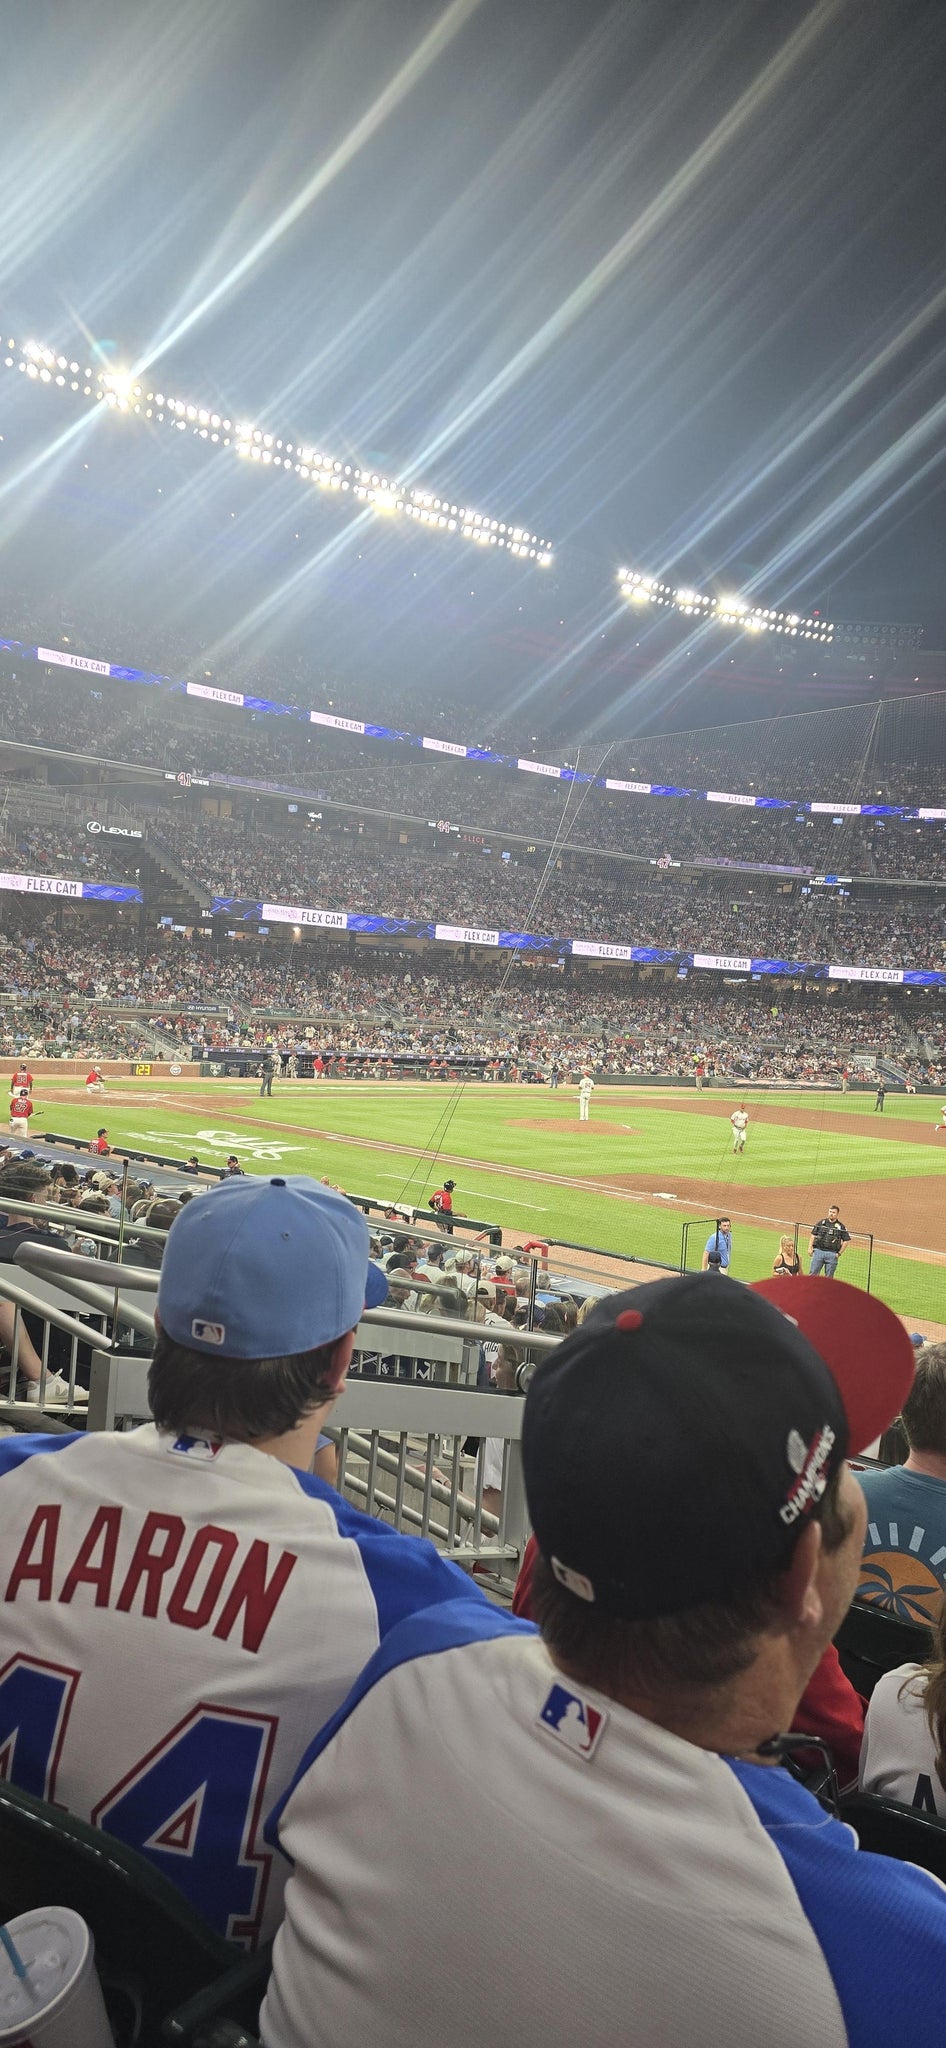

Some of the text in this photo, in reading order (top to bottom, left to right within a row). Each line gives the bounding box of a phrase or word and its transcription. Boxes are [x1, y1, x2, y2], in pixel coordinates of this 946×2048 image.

[70, 657, 107, 673] FLEX CAM
[212, 690, 241, 703] FLEX CAM
[334, 719, 362, 732] FLEX CAM
[442, 743, 465, 755] FLEX CAM
[536, 765, 559, 776] FLEX CAM
[177, 772, 191, 786] 41
[637, 783, 649, 791] CAM
[741, 796, 753, 804] CAM
[102, 825, 142, 838] LEXUS
[437, 820, 450, 833] 44
[26, 878, 53, 892] FLEX
[55, 881, 77, 895] CAM
[301, 911, 323, 924] FLEX
[325, 914, 343, 926] CAM
[463, 930, 496, 943] FLEX CAM
[598, 945, 628, 957] FLEX CAM
[715, 958, 748, 969] FLEX CAM
[860, 970, 899, 981] FLEX CAM
[5, 1504, 297, 1654] AARON
